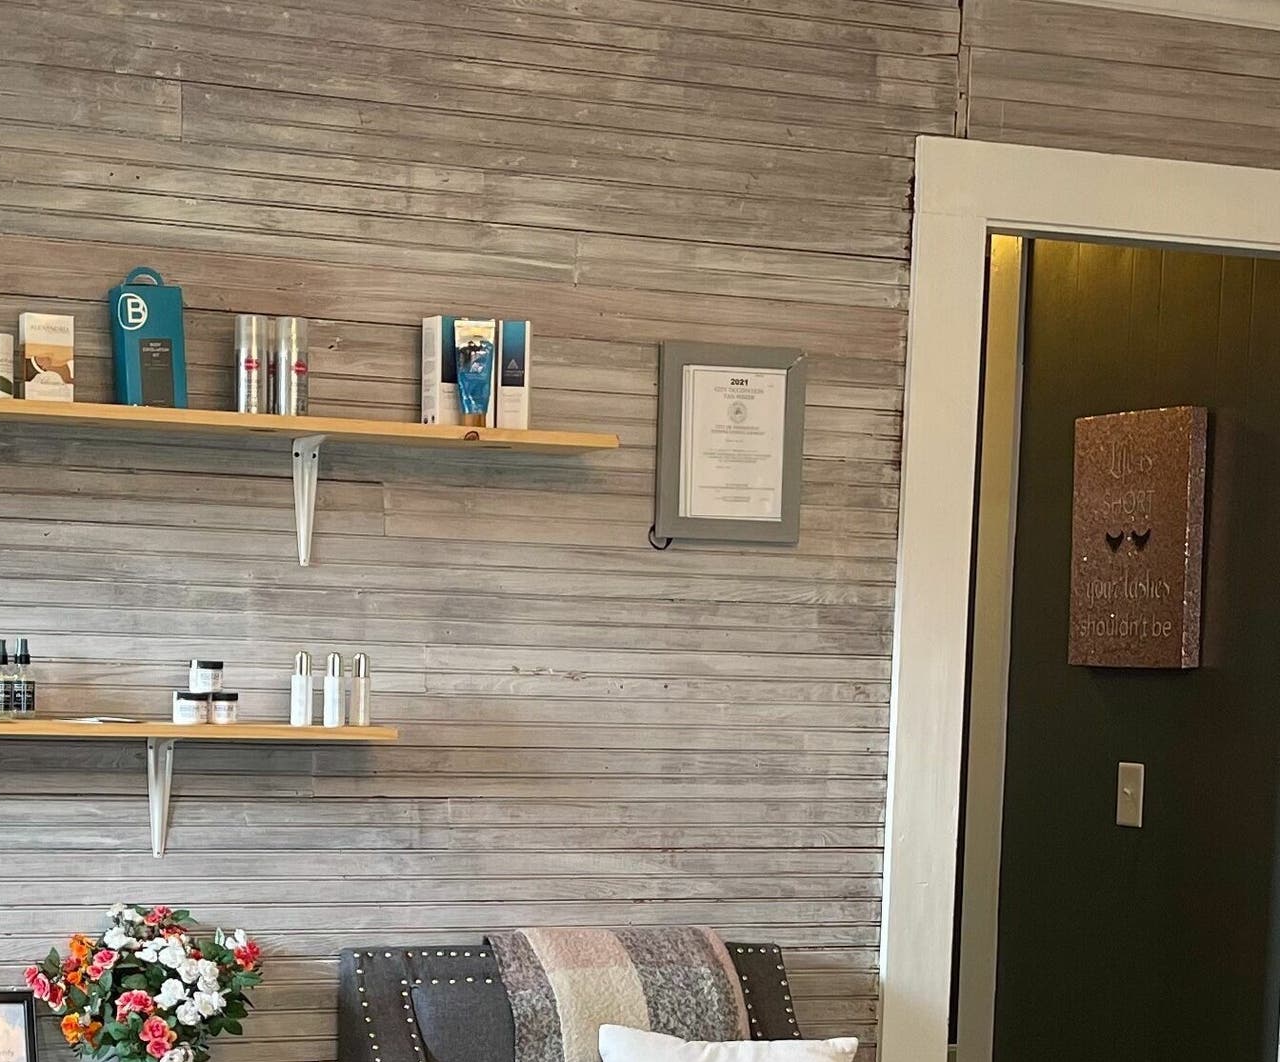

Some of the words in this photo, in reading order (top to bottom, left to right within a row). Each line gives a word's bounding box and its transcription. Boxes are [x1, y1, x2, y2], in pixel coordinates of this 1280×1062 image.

[730, 378, 749, 387] 2021
[1103, 489, 1155, 515] SHORT
[1080, 613, 1147, 637] shouldn't
[1151, 615, 1172, 637] be
